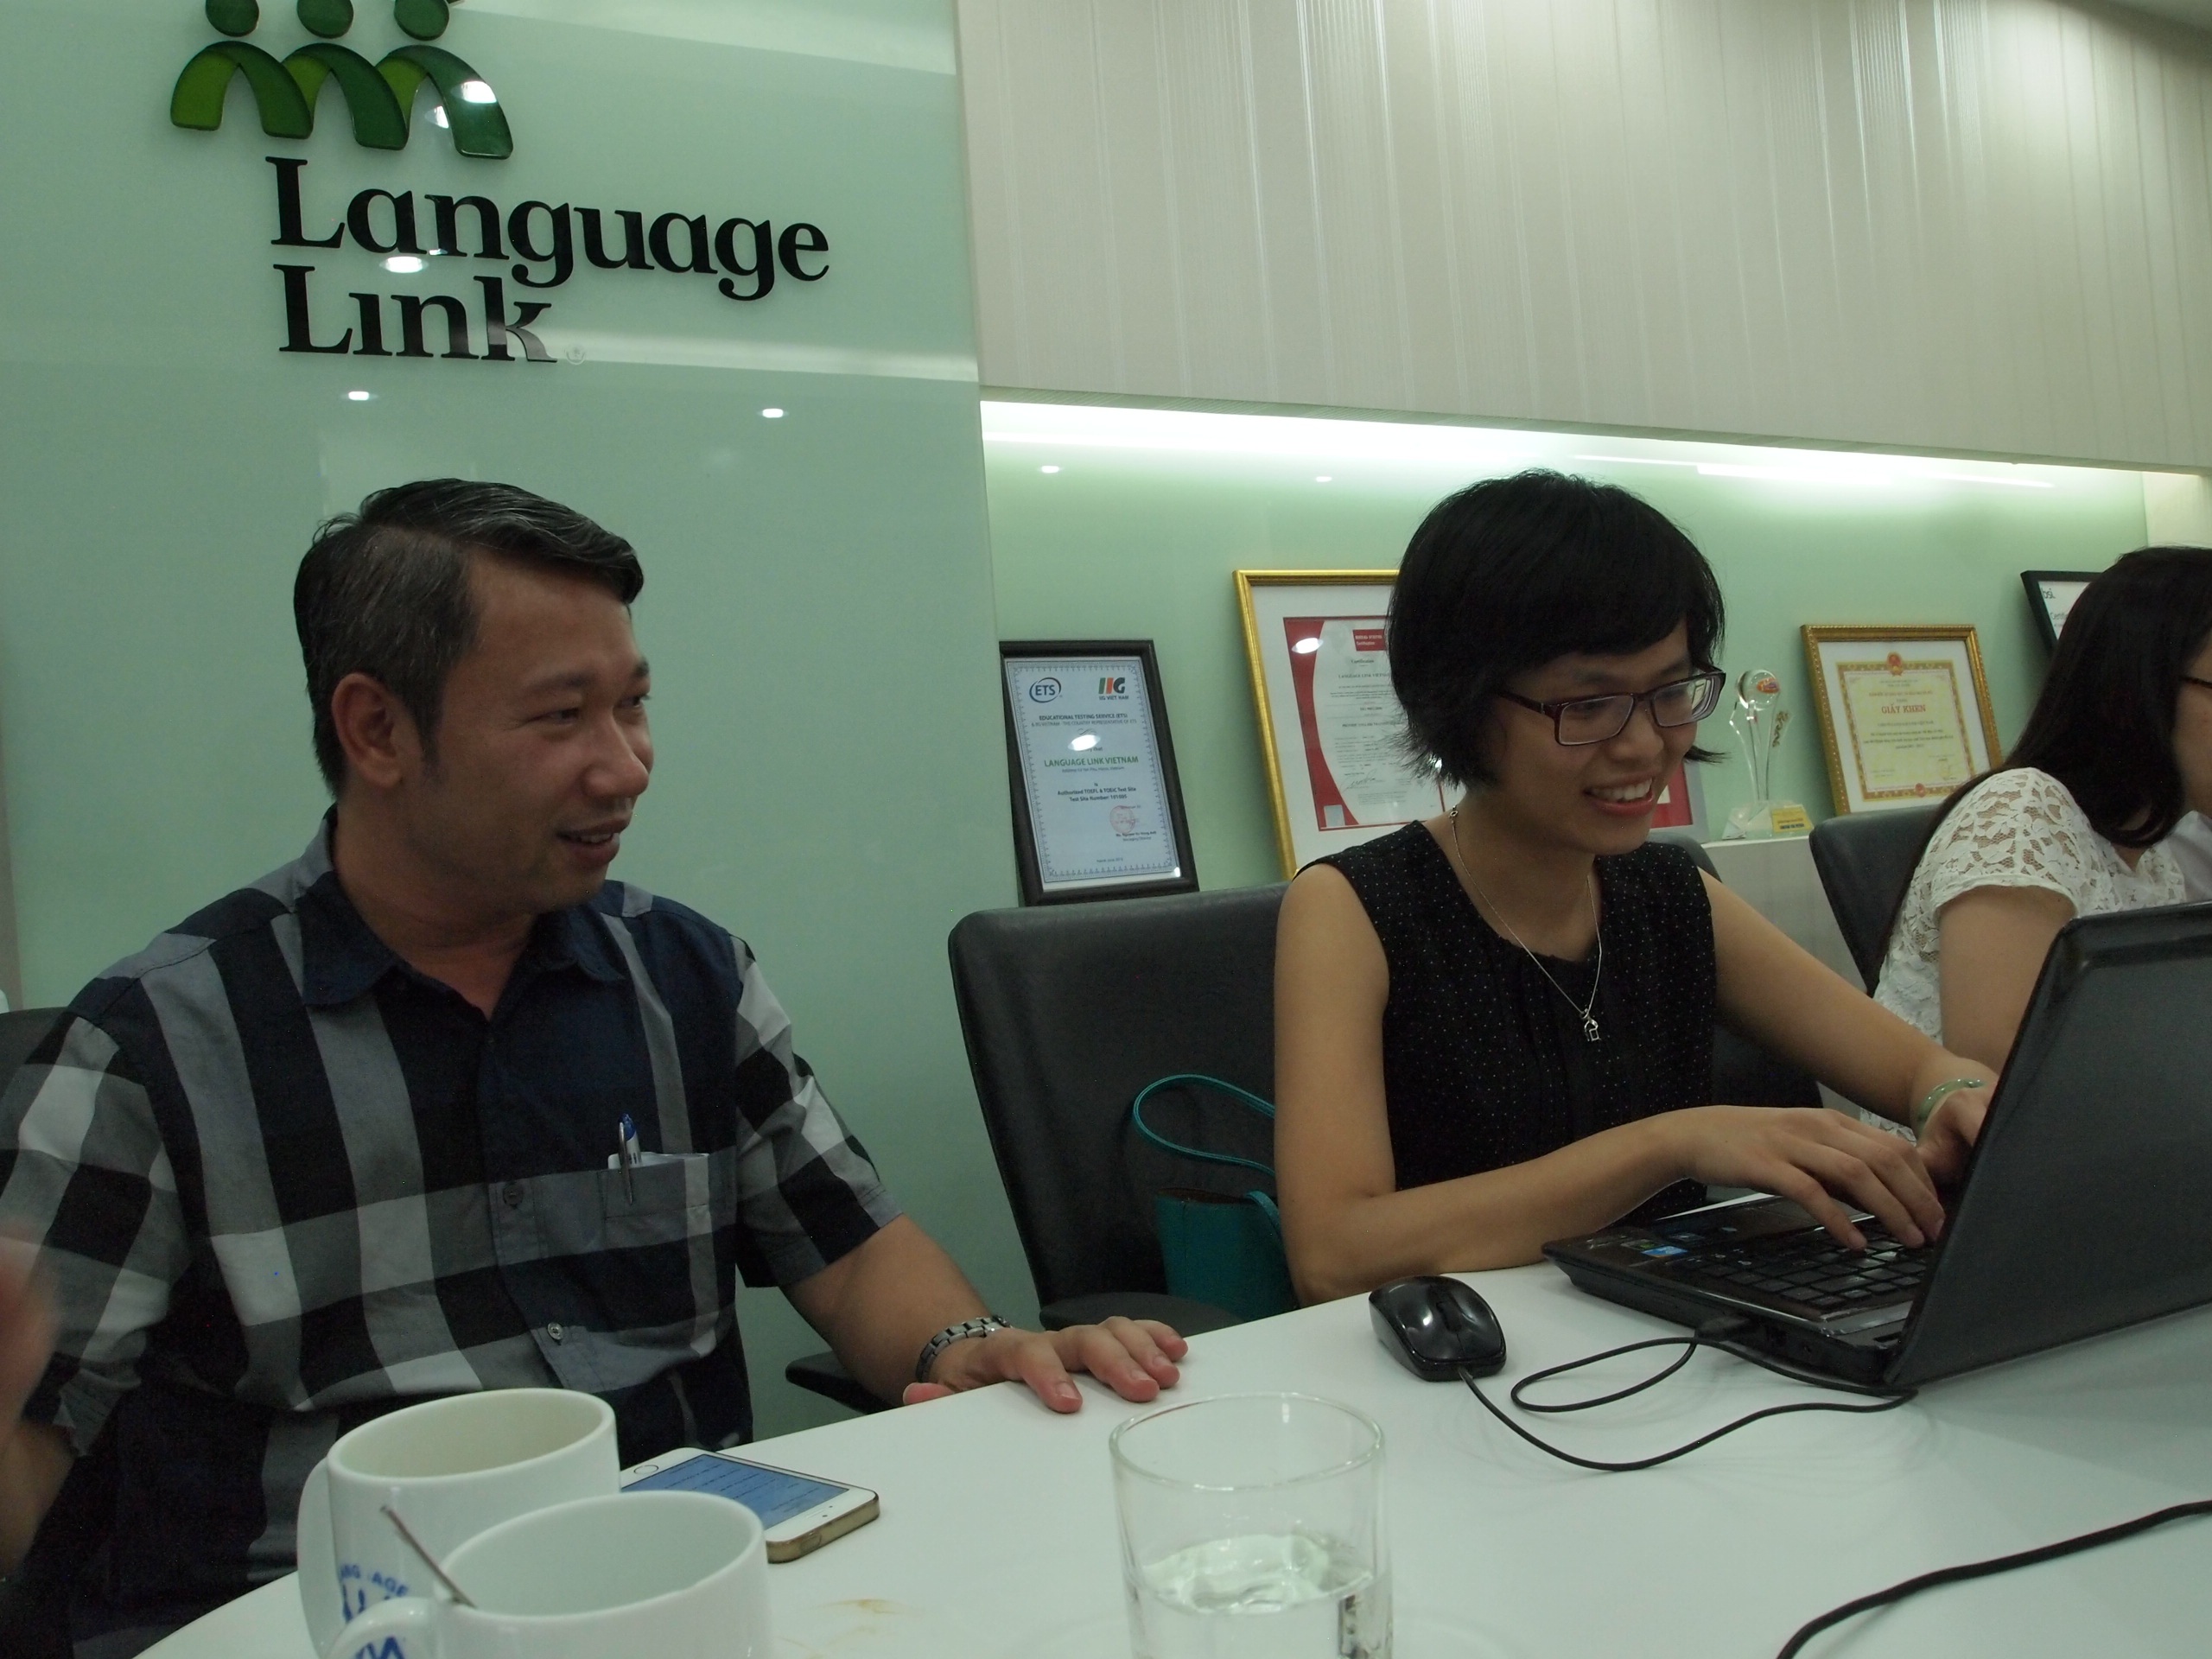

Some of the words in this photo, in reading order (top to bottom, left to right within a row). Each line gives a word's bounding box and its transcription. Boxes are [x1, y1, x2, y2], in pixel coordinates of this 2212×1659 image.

[264, 156, 830, 302] Language
[272, 264, 558, 364] Link
[1035, 684, 1056, 696] ETS
[1903, 704, 1926, 714] KHEN
[1044, 758, 1086, 767] LANGUAGE
[1086, 757, 1105, 766] LINK
[1105, 755, 1139, 765] VIETNAM
